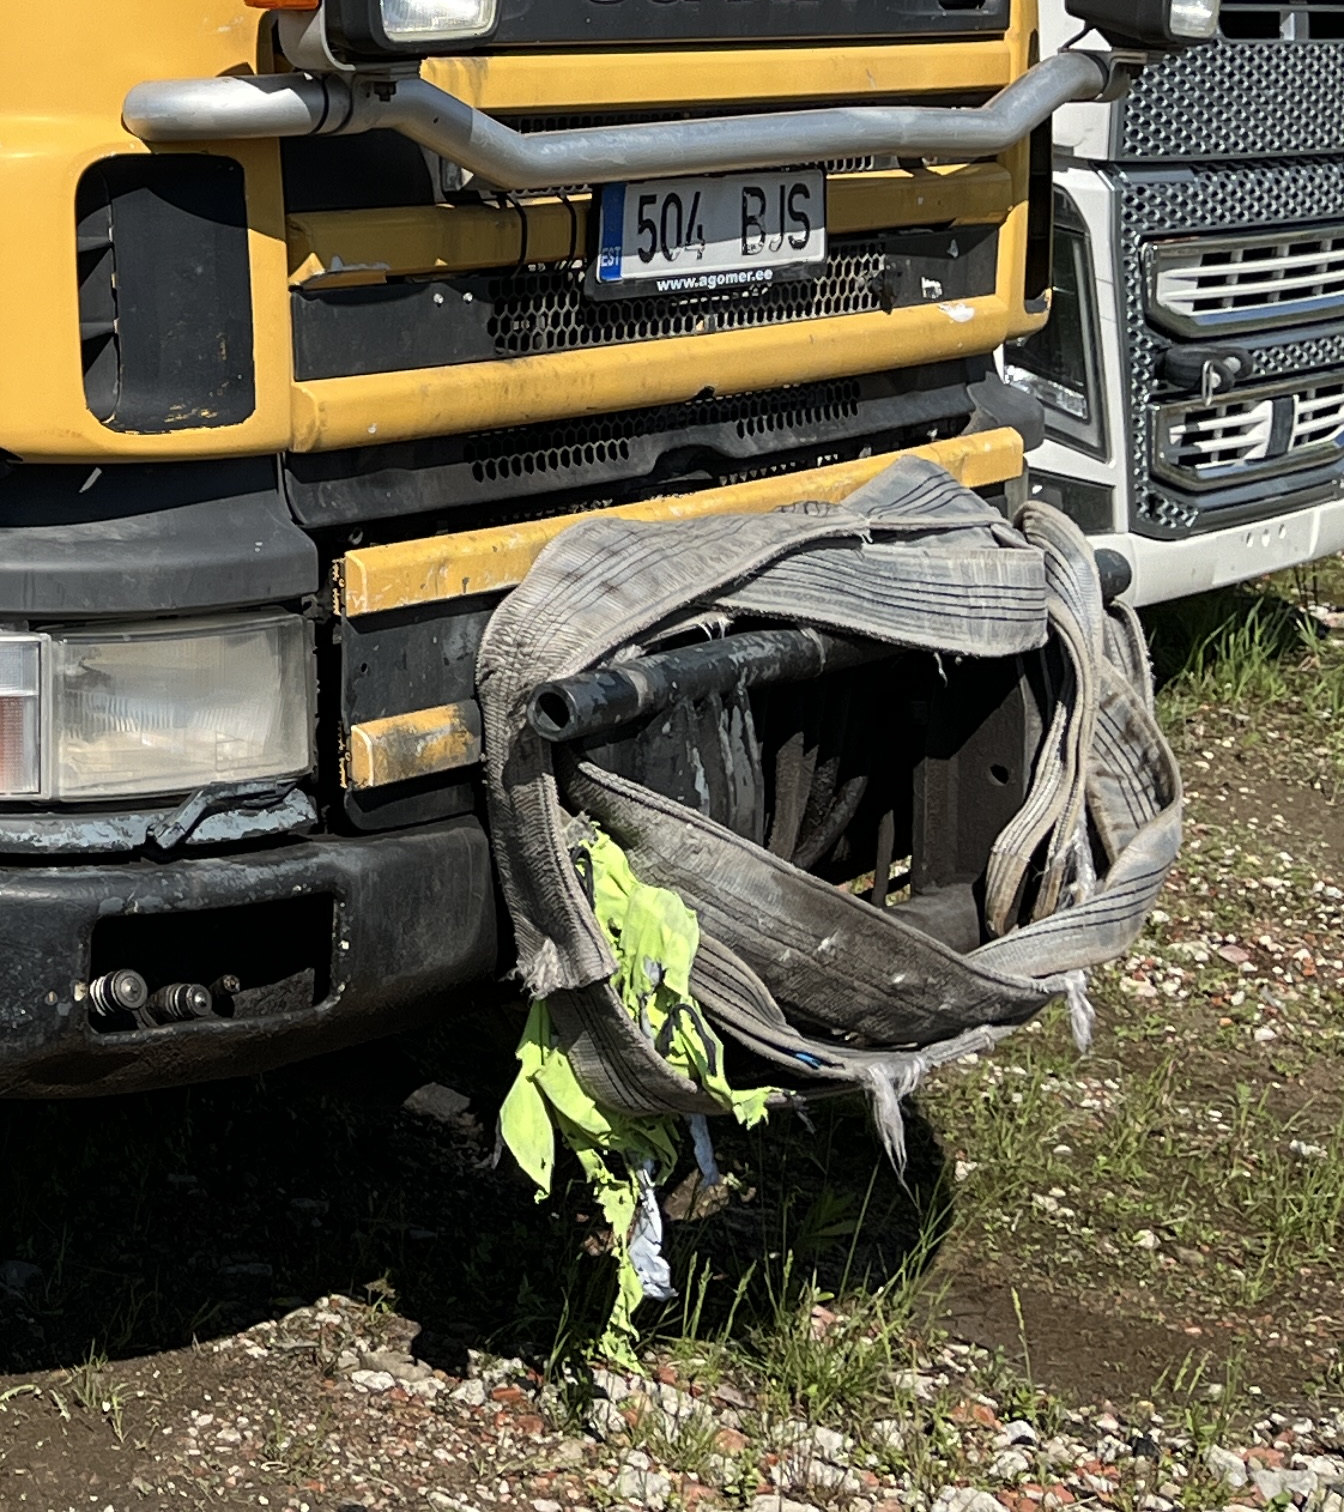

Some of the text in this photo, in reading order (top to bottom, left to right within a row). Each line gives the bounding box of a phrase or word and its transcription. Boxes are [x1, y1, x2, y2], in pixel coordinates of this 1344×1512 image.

[636, 182, 811, 264] 504 BJS
[600, 245, 622, 267] EST
[656, 267, 774, 292] www.agomer.ee
